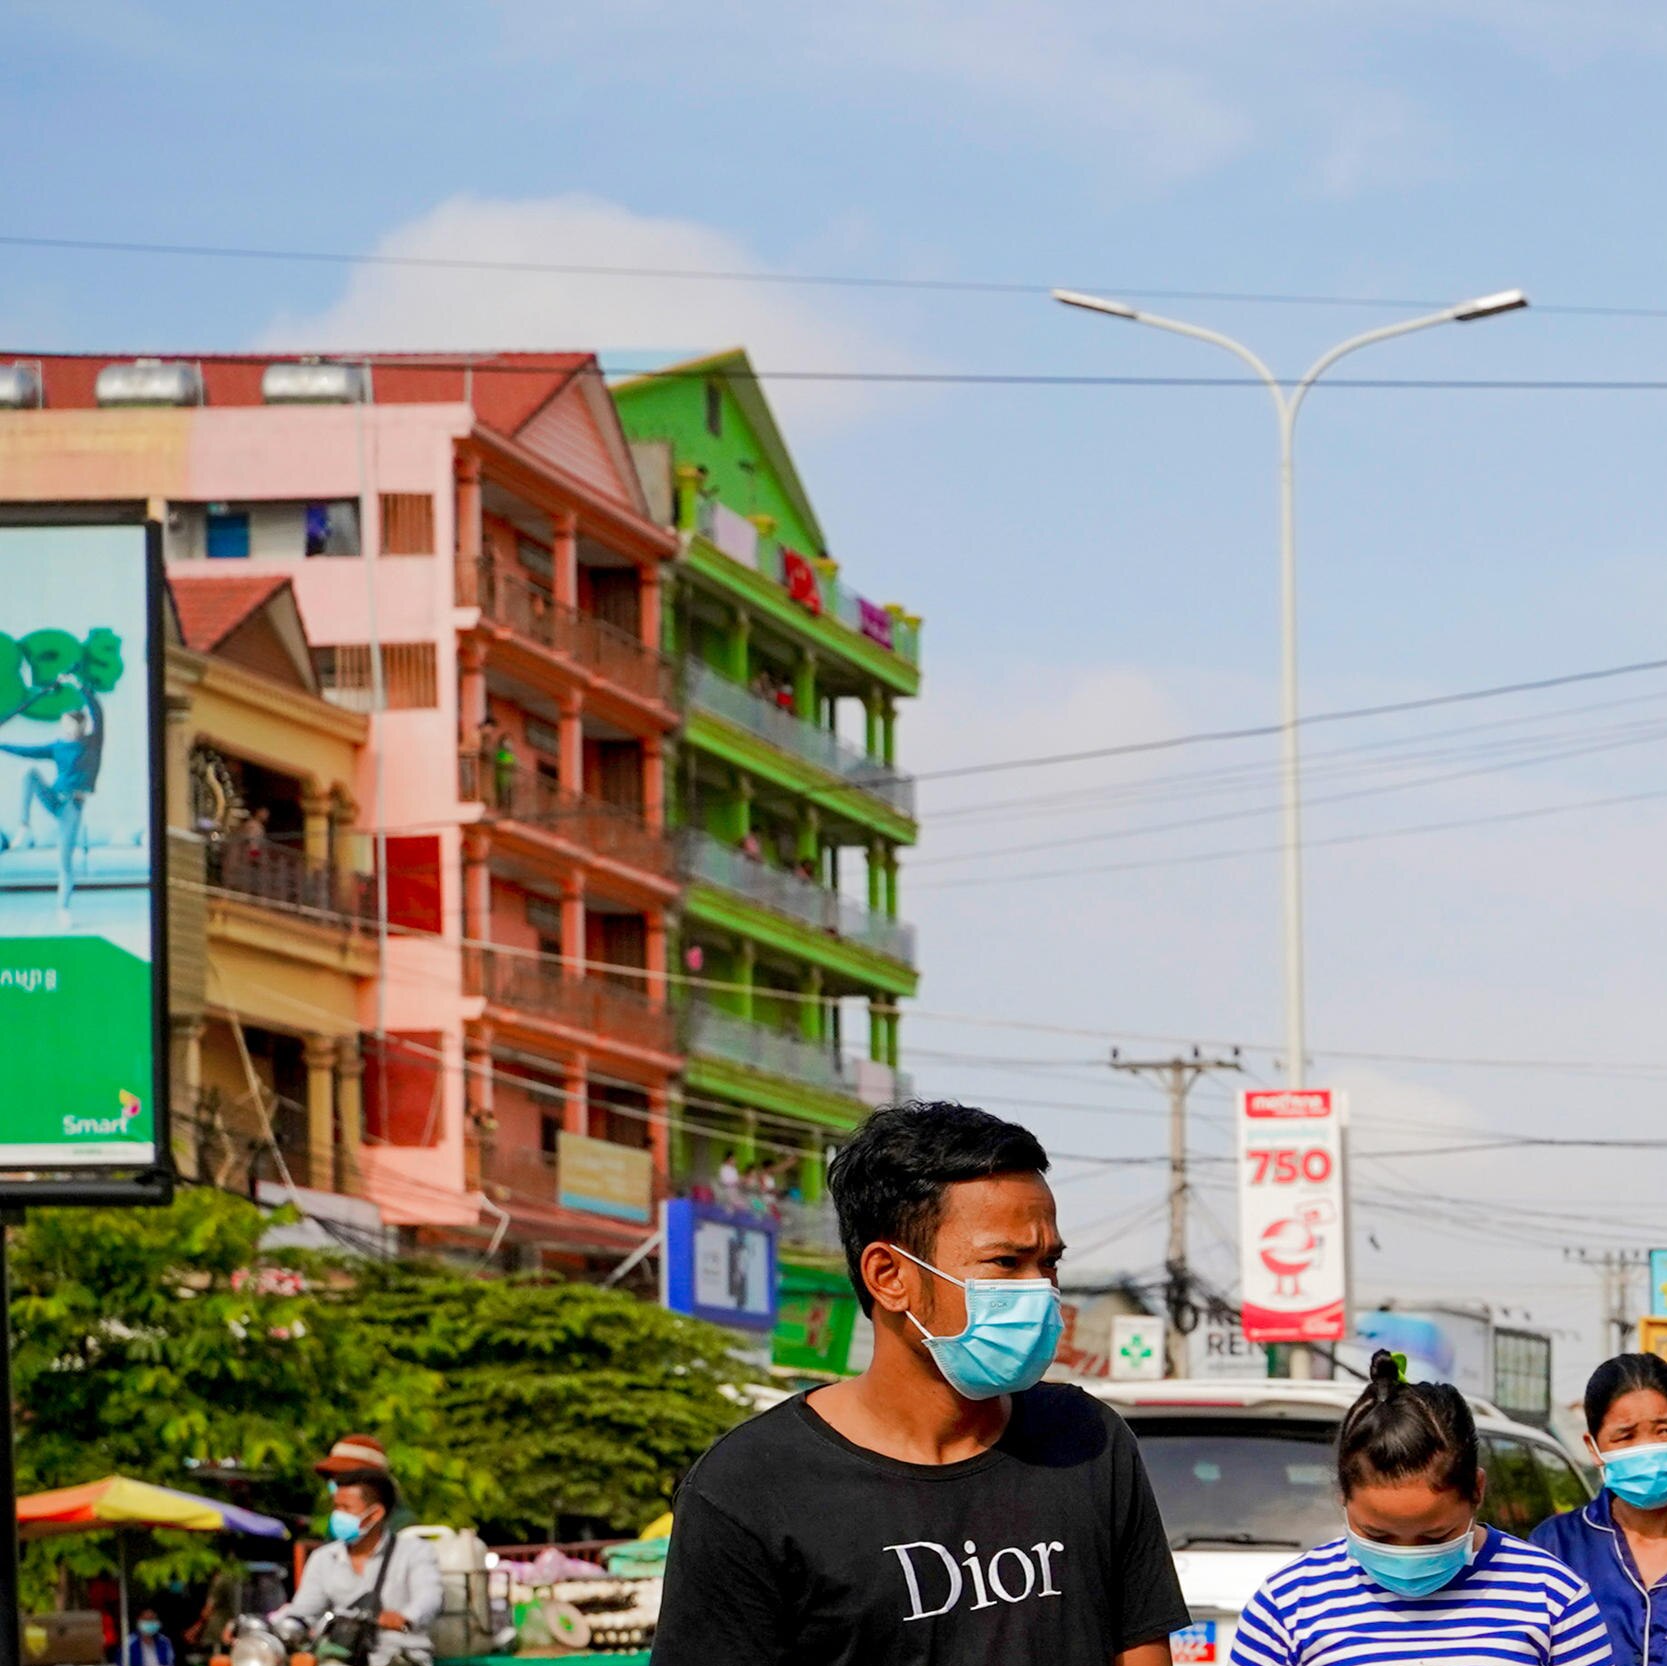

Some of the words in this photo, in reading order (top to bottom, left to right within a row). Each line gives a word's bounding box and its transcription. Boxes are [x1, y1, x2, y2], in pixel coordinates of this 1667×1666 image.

[63, 1114, 130, 1136] Smart
[1246, 1149, 1332, 1184] 750
[882, 1540, 1065, 1621] Dior
